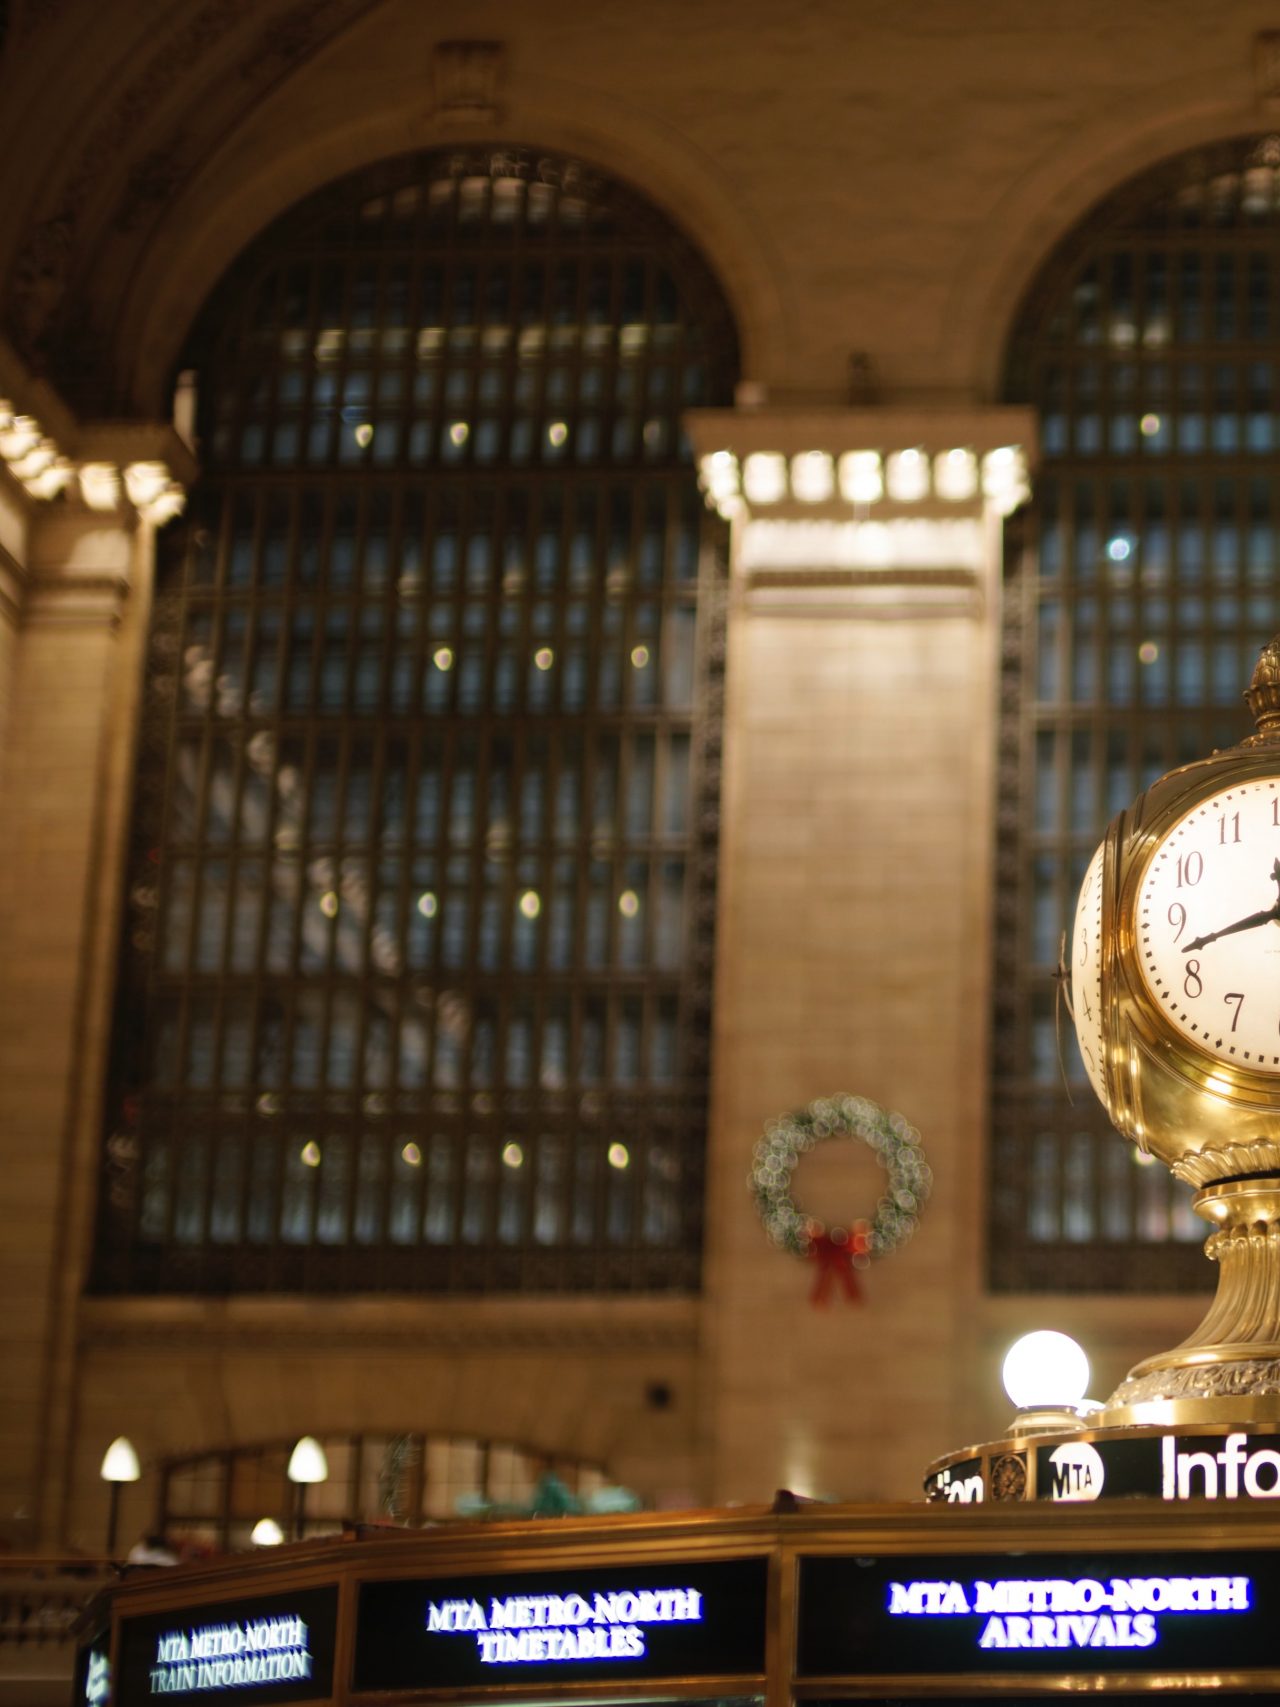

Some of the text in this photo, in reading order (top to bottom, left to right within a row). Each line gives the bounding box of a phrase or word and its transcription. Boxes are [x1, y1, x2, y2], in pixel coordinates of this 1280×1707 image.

[1217, 811, 1242, 845] 11
[1176, 850, 1204, 888] 10
[1167, 902, 1187, 944] 9
[1183, 959, 1203, 999] 8
[1223, 992, 1245, 1032] 7
[1049, 1460, 1095, 1500] MTA
[426, 1587, 702, 1632] MTA METRO-NORTH
[890, 1577, 1250, 1614] MTA METRO-NORTH
[157, 1616, 308, 1663] MTA METRO-NORTH
[477, 1624, 645, 1663] TIMETABLES
[979, 1614, 1156, 1648] ARRIVALS
[150, 1664, 198, 1694] TRAIN
[196, 1648, 313, 1688] INFORMATION
